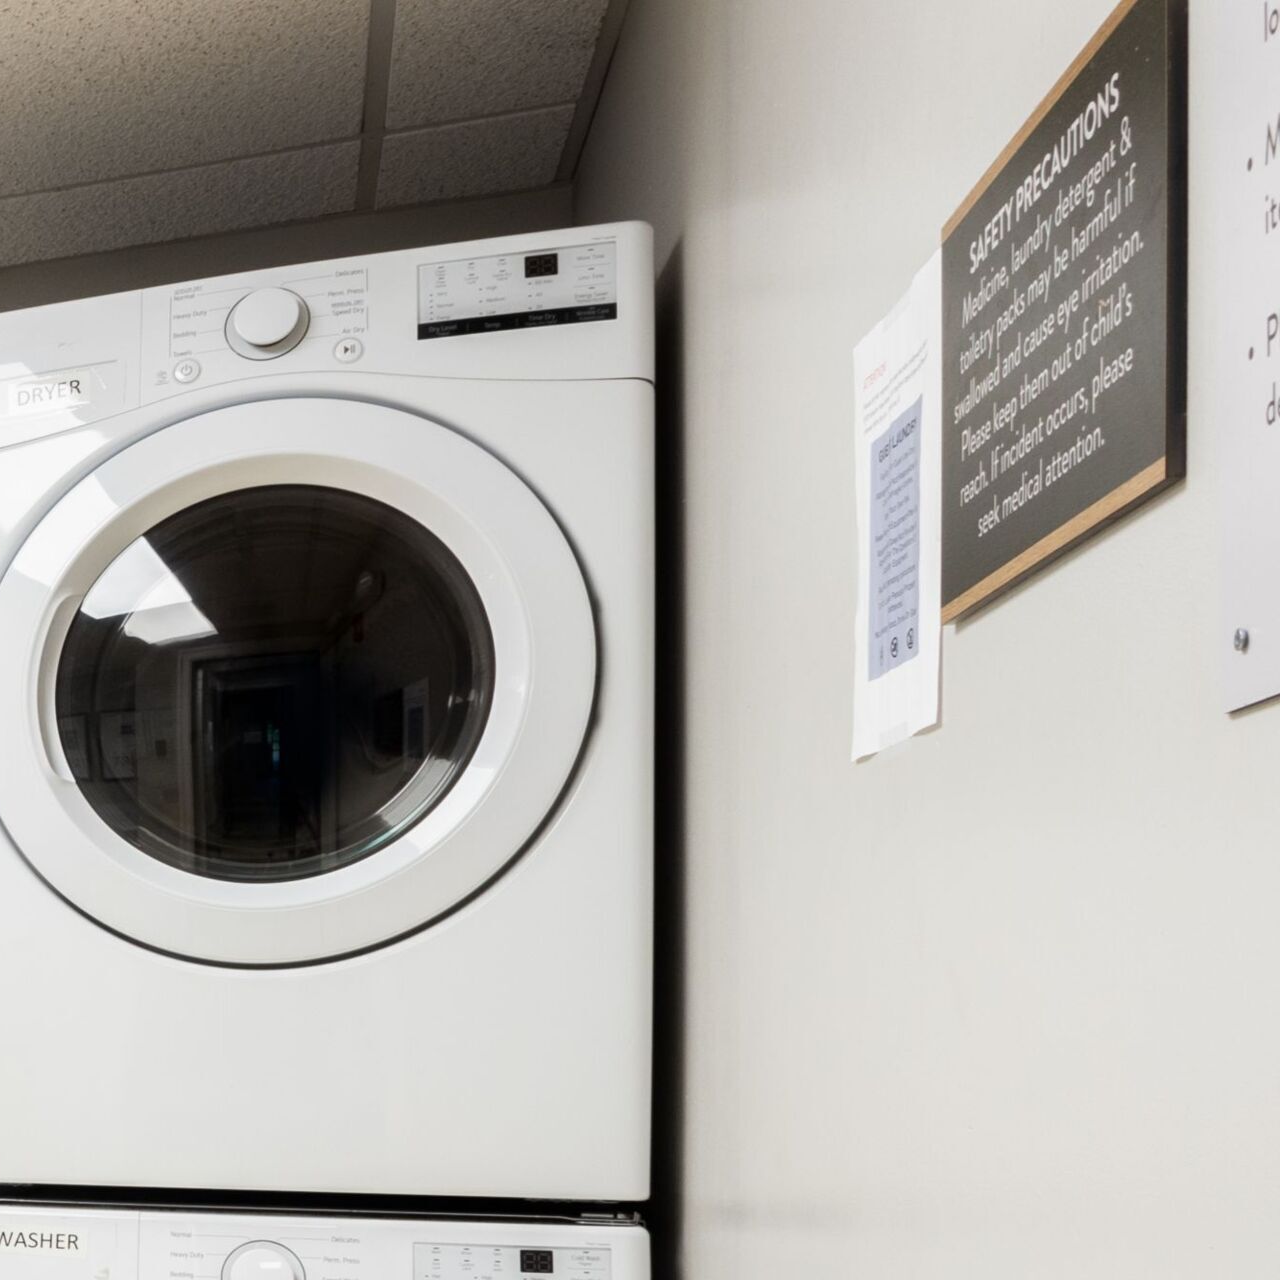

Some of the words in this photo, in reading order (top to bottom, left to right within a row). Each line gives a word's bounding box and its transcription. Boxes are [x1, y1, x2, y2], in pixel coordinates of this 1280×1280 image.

[962, 265, 1009, 329] Medicine,
[1011, 214, 1052, 275] laundry
[1054, 140, 1116, 227] detergent
[1120, 116, 1132, 156] &
[970, 196, 1014, 274] SAFETY
[1016, 72, 1120, 222] PRECAUTIONS
[1265, 194, 1280, 235] it
[954, 353, 1000, 425] swallowed
[1002, 331, 1021, 379] and
[1023, 313, 1055, 358] cause
[1057, 289, 1079, 335] eye
[1081, 230, 1144, 304] irritation.
[960, 324, 995, 375] toiletry
[996, 288, 1026, 351] packs
[1027, 264, 1052, 307] may
[1054, 245, 1069, 280] be
[1071, 178, 1121, 262] harmful
[1125, 162, 1136, 208] if
[17, 379, 82, 406] DRYER
[960, 460, 989, 508] reach.
[990, 445, 1000, 482] If
[1000, 417, 1044, 474] incident
[1046, 386, 1089, 437] occurs,
[1092, 347, 1133, 415] please
[961, 420, 991, 462] Please
[993, 396, 1017, 433] keep
[1019, 368, 1049, 411] them
[1051, 342, 1072, 382] out
[1074, 316, 1090, 360] of
[1091, 282, 1133, 347] child's
[978, 494, 1000, 538] seek
[1001, 458, 1043, 520] medical
[1045, 425, 1105, 488] attention.
